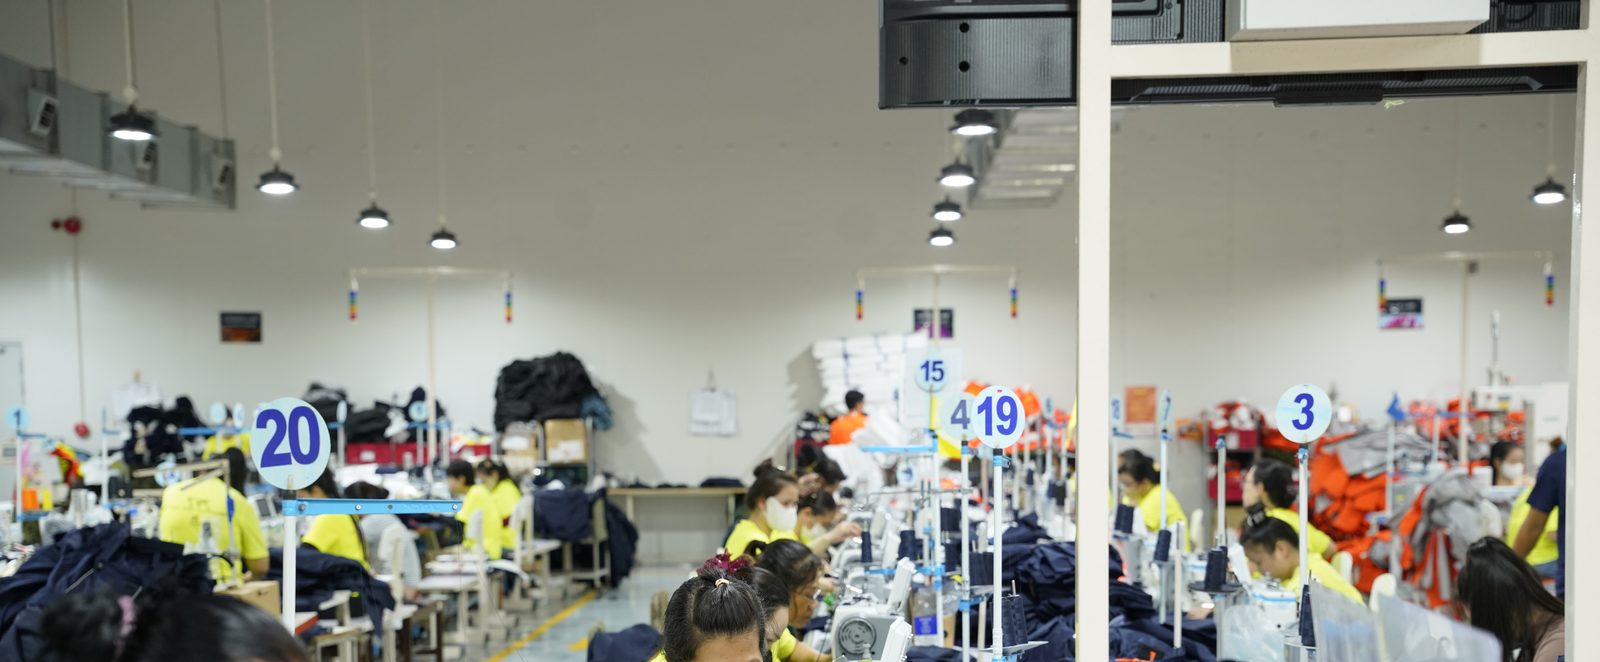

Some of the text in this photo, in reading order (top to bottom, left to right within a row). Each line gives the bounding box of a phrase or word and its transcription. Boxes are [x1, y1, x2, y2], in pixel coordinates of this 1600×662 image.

[920, 360, 945, 382] 15
[950, 399, 971, 430] 4
[977, 395, 1018, 436] 19
[1292, 393, 1315, 431] 3
[256, 406, 320, 468] 20
